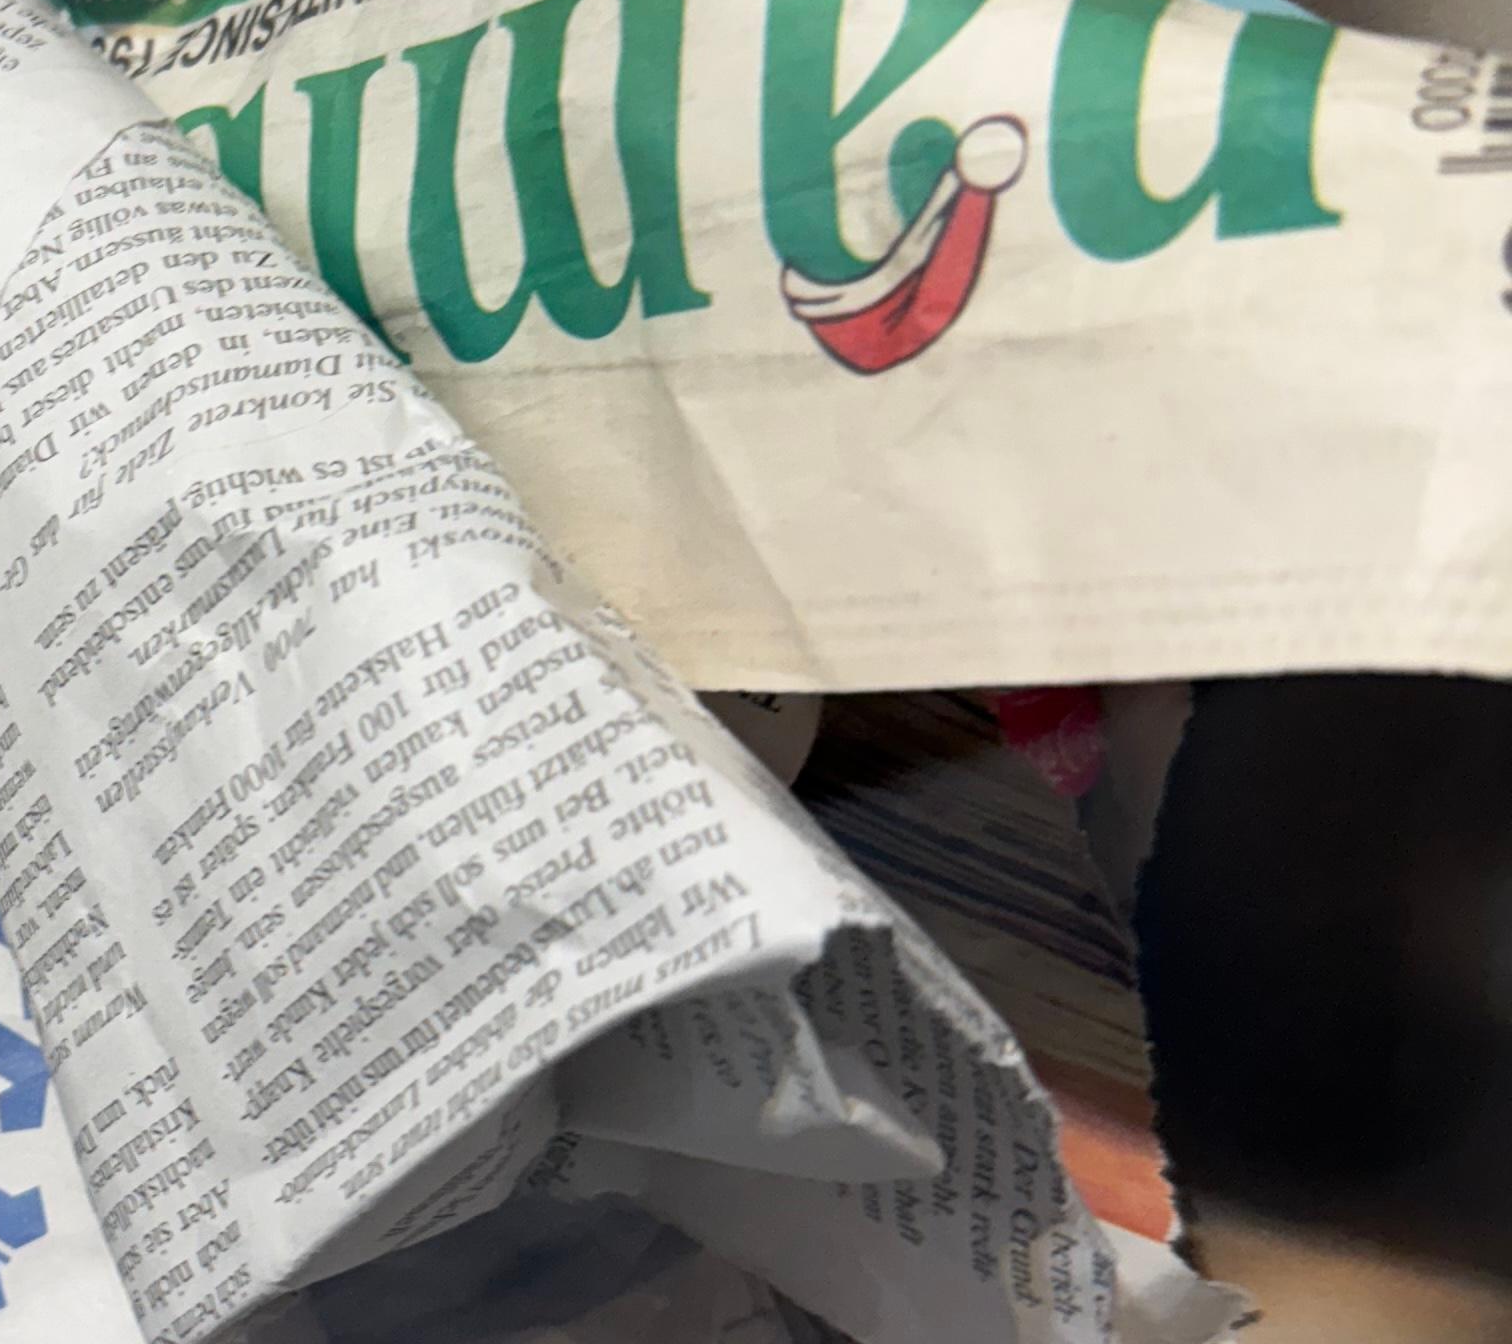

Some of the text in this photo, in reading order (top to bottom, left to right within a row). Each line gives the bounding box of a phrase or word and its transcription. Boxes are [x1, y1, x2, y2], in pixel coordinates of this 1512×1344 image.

[73, 176, 201, 208] erlauben
[64, 205, 149, 246] völlig
[0, 224, 188, 320] äussern. Aber
[161, 250, 219, 276] den
[229, 252, 273, 274] Zu
[4, 279, 234, 394] des Umsatzes aus.
[102, 314, 190, 379] macht
[217, 334, 248, 359] in
[19, 367, 104, 424] dieser
[120, 343, 211, 401] denen
[345, 382, 397, 408] Sie
[65, 400, 114, 437] wir
[74, 354, 340, 478] Diamantschmuck?
[184, 388, 335, 438] konkrete
[111, 428, 184, 483] Ziele
[311, 461, 347, 482] es
[356, 451, 396, 480] ist
[66, 477, 119, 520] für
[97, 498, 189, 590] präsent
[338, 512, 423, 548] Eine
[72, 576, 105, 607] zu
[126, 494, 346, 664] für Luxusmarken.
[327, 558, 389, 607] hat
[37, 532, 219, 705] uns entscheidend.
[477, 607, 566, 677] band
[70, 595, 285, 784] Allgegenwärtigkeit
[417, 657, 478, 701] für
[93, 667, 263, 812] Verkaufsstellen
[149, 581, 522, 863] eine Halskette für 1000 Franken.
[354, 690, 417, 747] 100
[470, 689, 594, 773] Preises
[253, 729, 367, 817] Franken;
[363, 711, 474, 787] kaufen
[268, 781, 364, 878] vielleicht
[289, 761, 466, 912] ausgeschlossen
[552, 779, 619, 838] Bei
[194, 814, 265, 880] später
[489, 816, 550, 865] uns
[656, 820, 728, 870] nen
[171, 872, 207, 908] ist
[229, 865, 271, 904] ein
[372, 842, 425, 898] und
[434, 854, 489, 910] soll
[605, 854, 658, 901] ab.
[674, 864, 746, 913] Wir
[150, 896, 180, 925] es
[286, 878, 380, 971] niemand
[388, 889, 440, 945] sich
[236, 776, 718, 1121] höhte Preise oder vorgespielte Knapp-
[330, 921, 401, 986] jeder
[572, 905, 679, 981] lehnen
[653, 910, 767, 982] Luxus
[183, 946, 247, 1003] Junge
[249, 950, 294, 1001] soll
[434, 938, 547, 1034] bedeutet
[201, 986, 259, 1042] wegen
[263, 977, 343, 1044] Kunde
[400, 1017, 446, 1054] für
[222, 1033, 269, 1086] wert-
[359, 1044, 408, 1088] uns
[309, 1075, 368, 1134] nicht
[262, 1111, 325, 1162] über-
[176, 1177, 243, 1229] Aber
